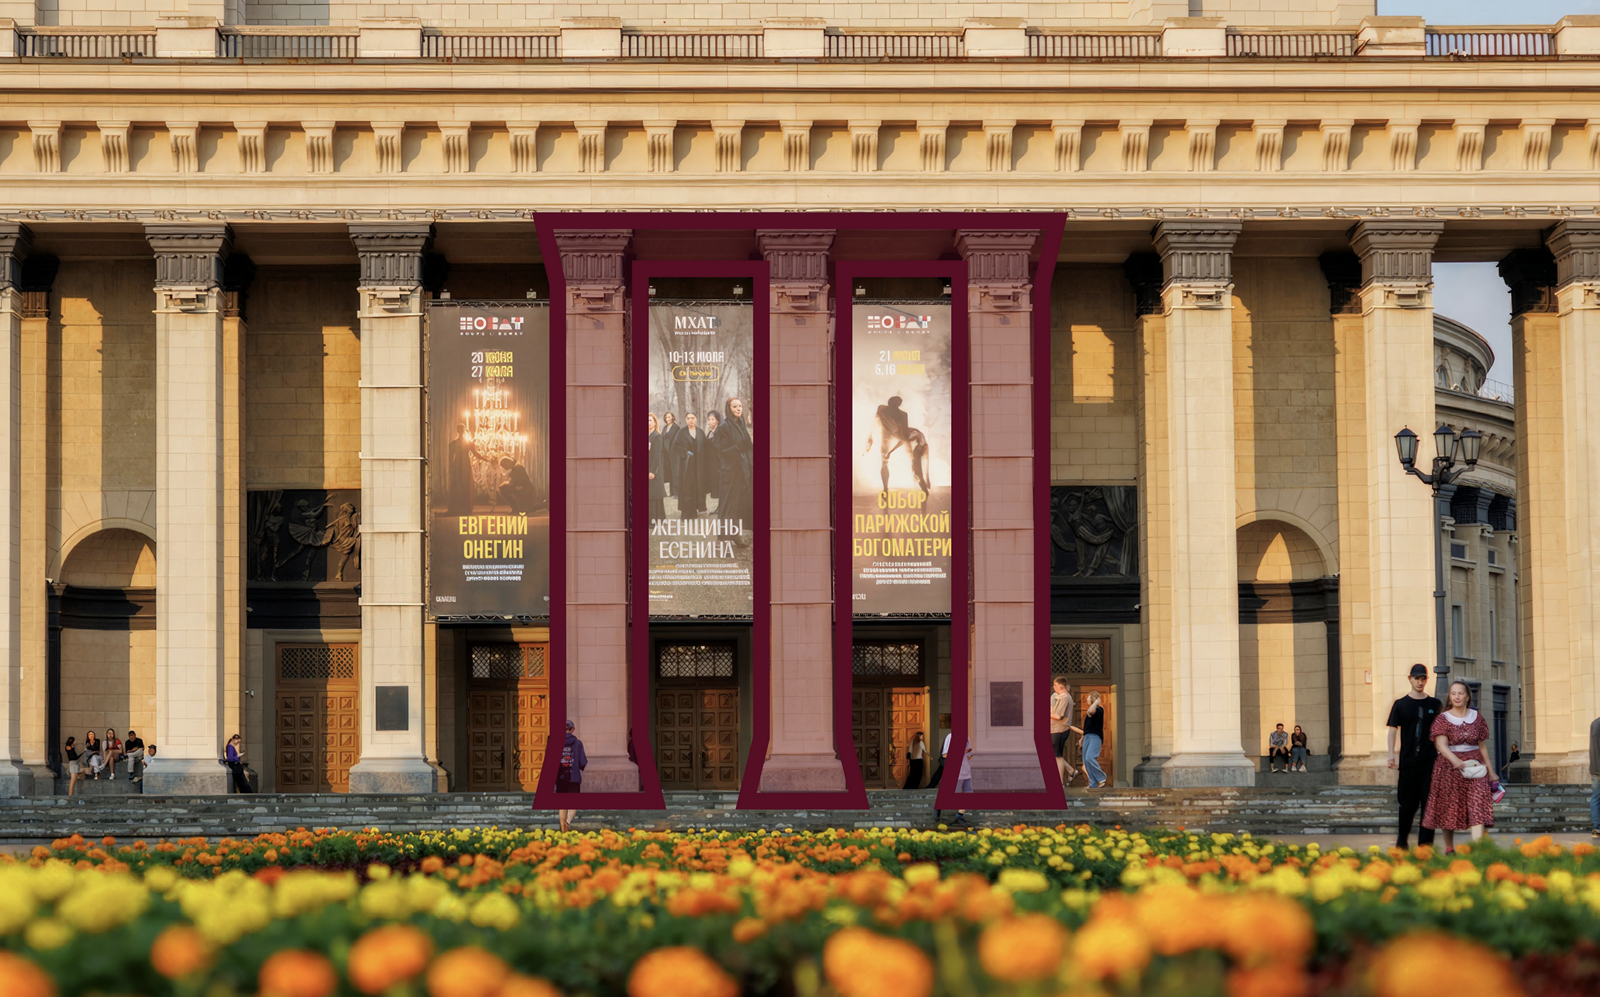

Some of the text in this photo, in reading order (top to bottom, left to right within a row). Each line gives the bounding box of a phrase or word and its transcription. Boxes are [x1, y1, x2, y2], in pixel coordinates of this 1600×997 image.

[674, 315, 717, 329] МХАТ
[471, 351, 484, 364] 20
[696, 351, 725, 363] ИЮЛЯ
[879, 350, 891, 361] 21
[471, 365, 483, 377] 27
[877, 489, 927, 509] СОБОР
[459, 511, 528, 535] ЕВГЕНИЙ
[651, 518, 743, 539] ЖЕНЩИНЫ
[855, 510, 950, 533] ПАРИЖСКОЙ
[463, 539, 524, 559] ОНЕГИН
[659, 540, 735, 559] ЕСЕНИНА
[853, 538, 952, 557] БОГОМАТЕРИ
